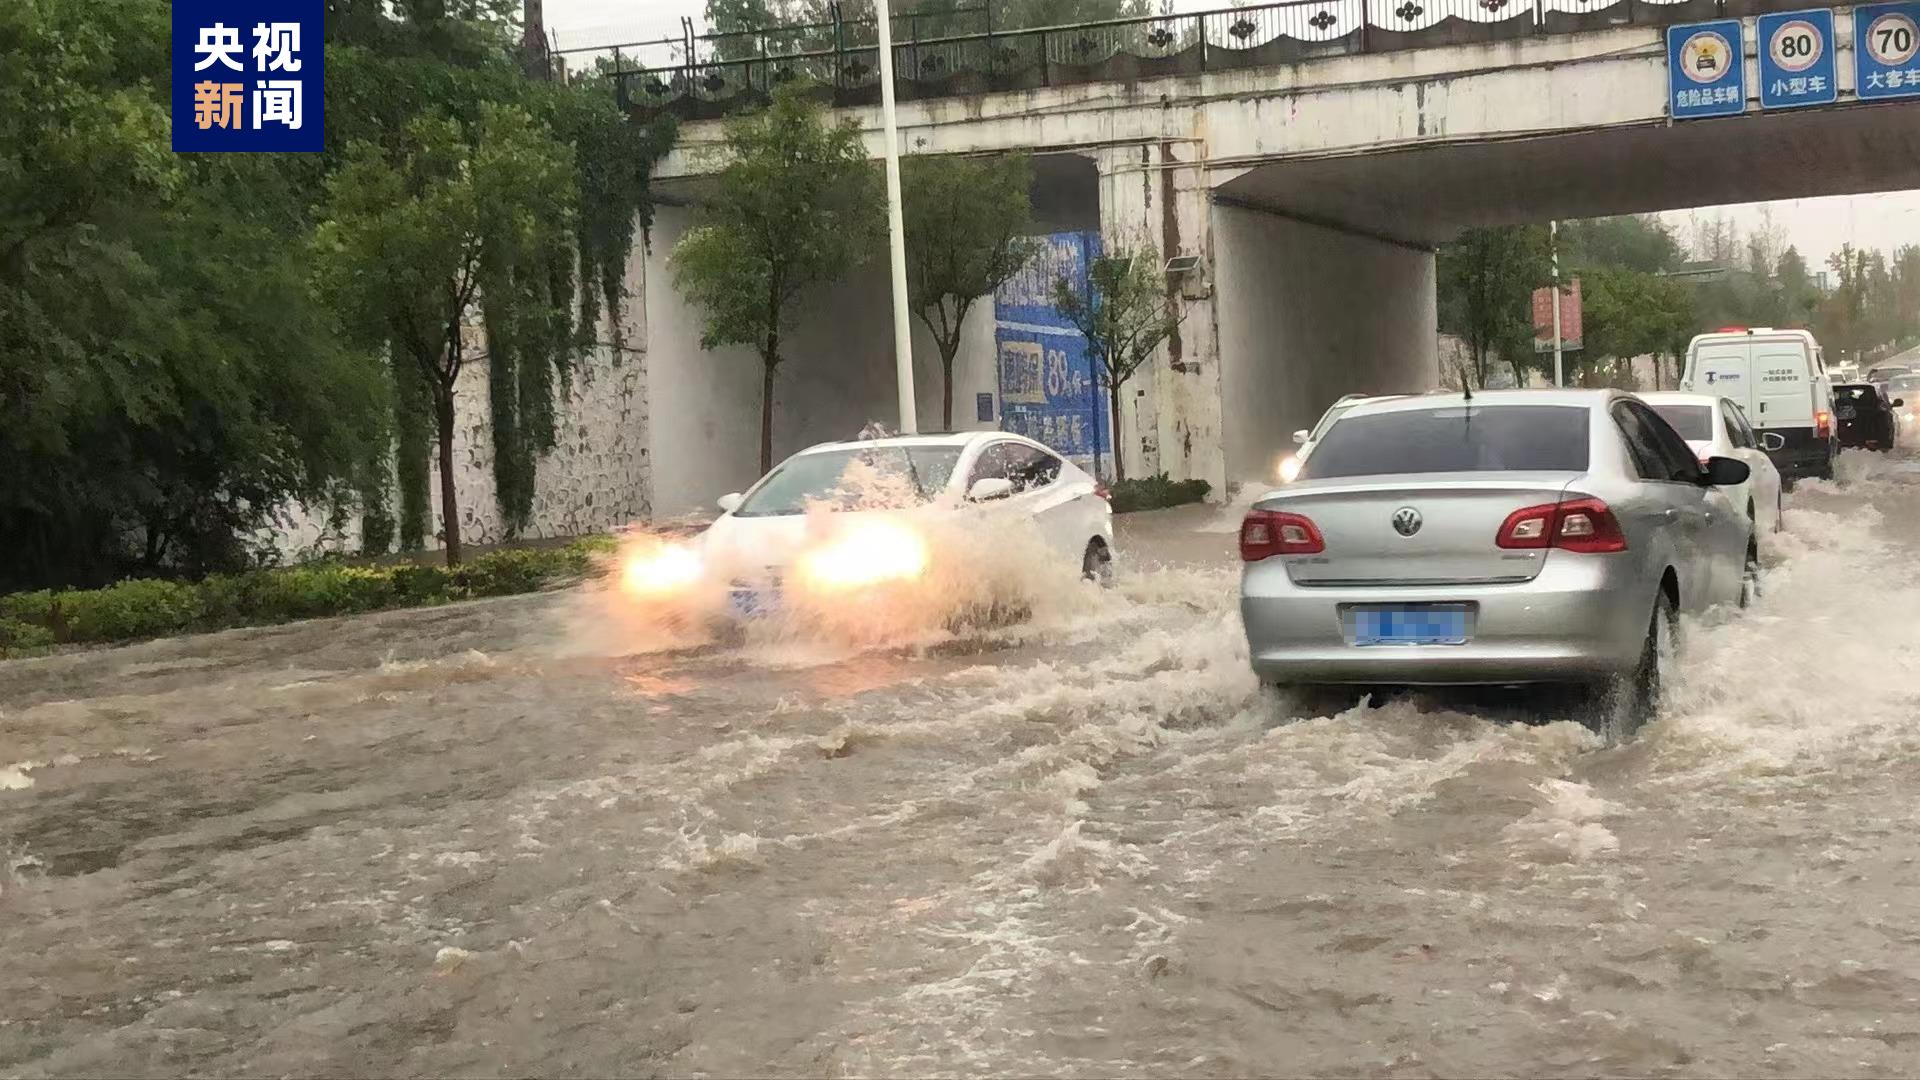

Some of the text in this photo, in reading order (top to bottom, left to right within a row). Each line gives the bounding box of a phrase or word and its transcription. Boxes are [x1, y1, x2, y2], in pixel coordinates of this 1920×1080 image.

[1781, 34, 1811, 58] 80
[1876, 27, 1911, 54] 70
[1770, 75, 1827, 97] 小型车
[1866, 68, 1920, 90] 大客车
[1676, 85, 1739, 108] 危险品车辆
